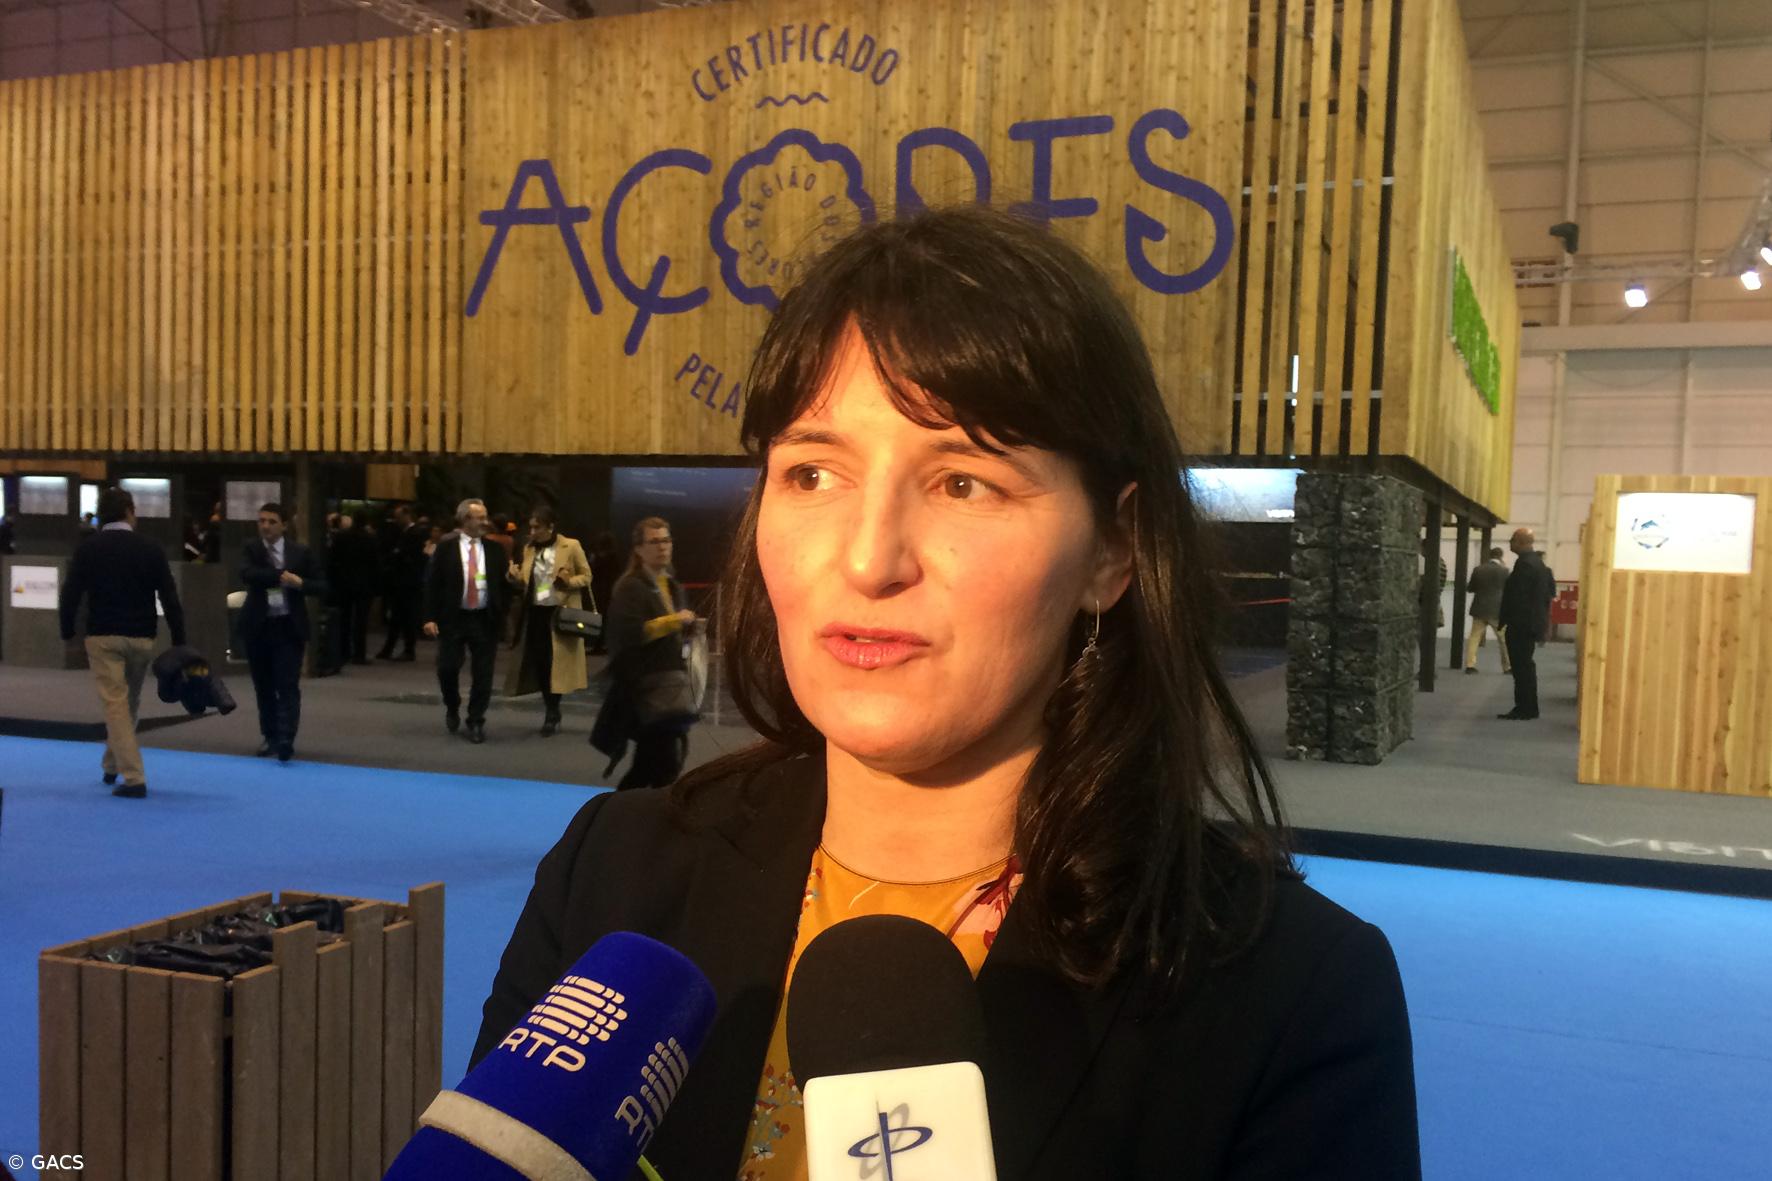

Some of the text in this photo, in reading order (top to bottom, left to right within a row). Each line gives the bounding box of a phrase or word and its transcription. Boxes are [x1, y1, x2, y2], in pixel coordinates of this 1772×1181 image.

[691, 22, 899, 102] CERTIFICADO
[674, 352, 742, 419] PELA
[498, 1027, 587, 1073] RTP
[614, 1095, 656, 1153] RT
